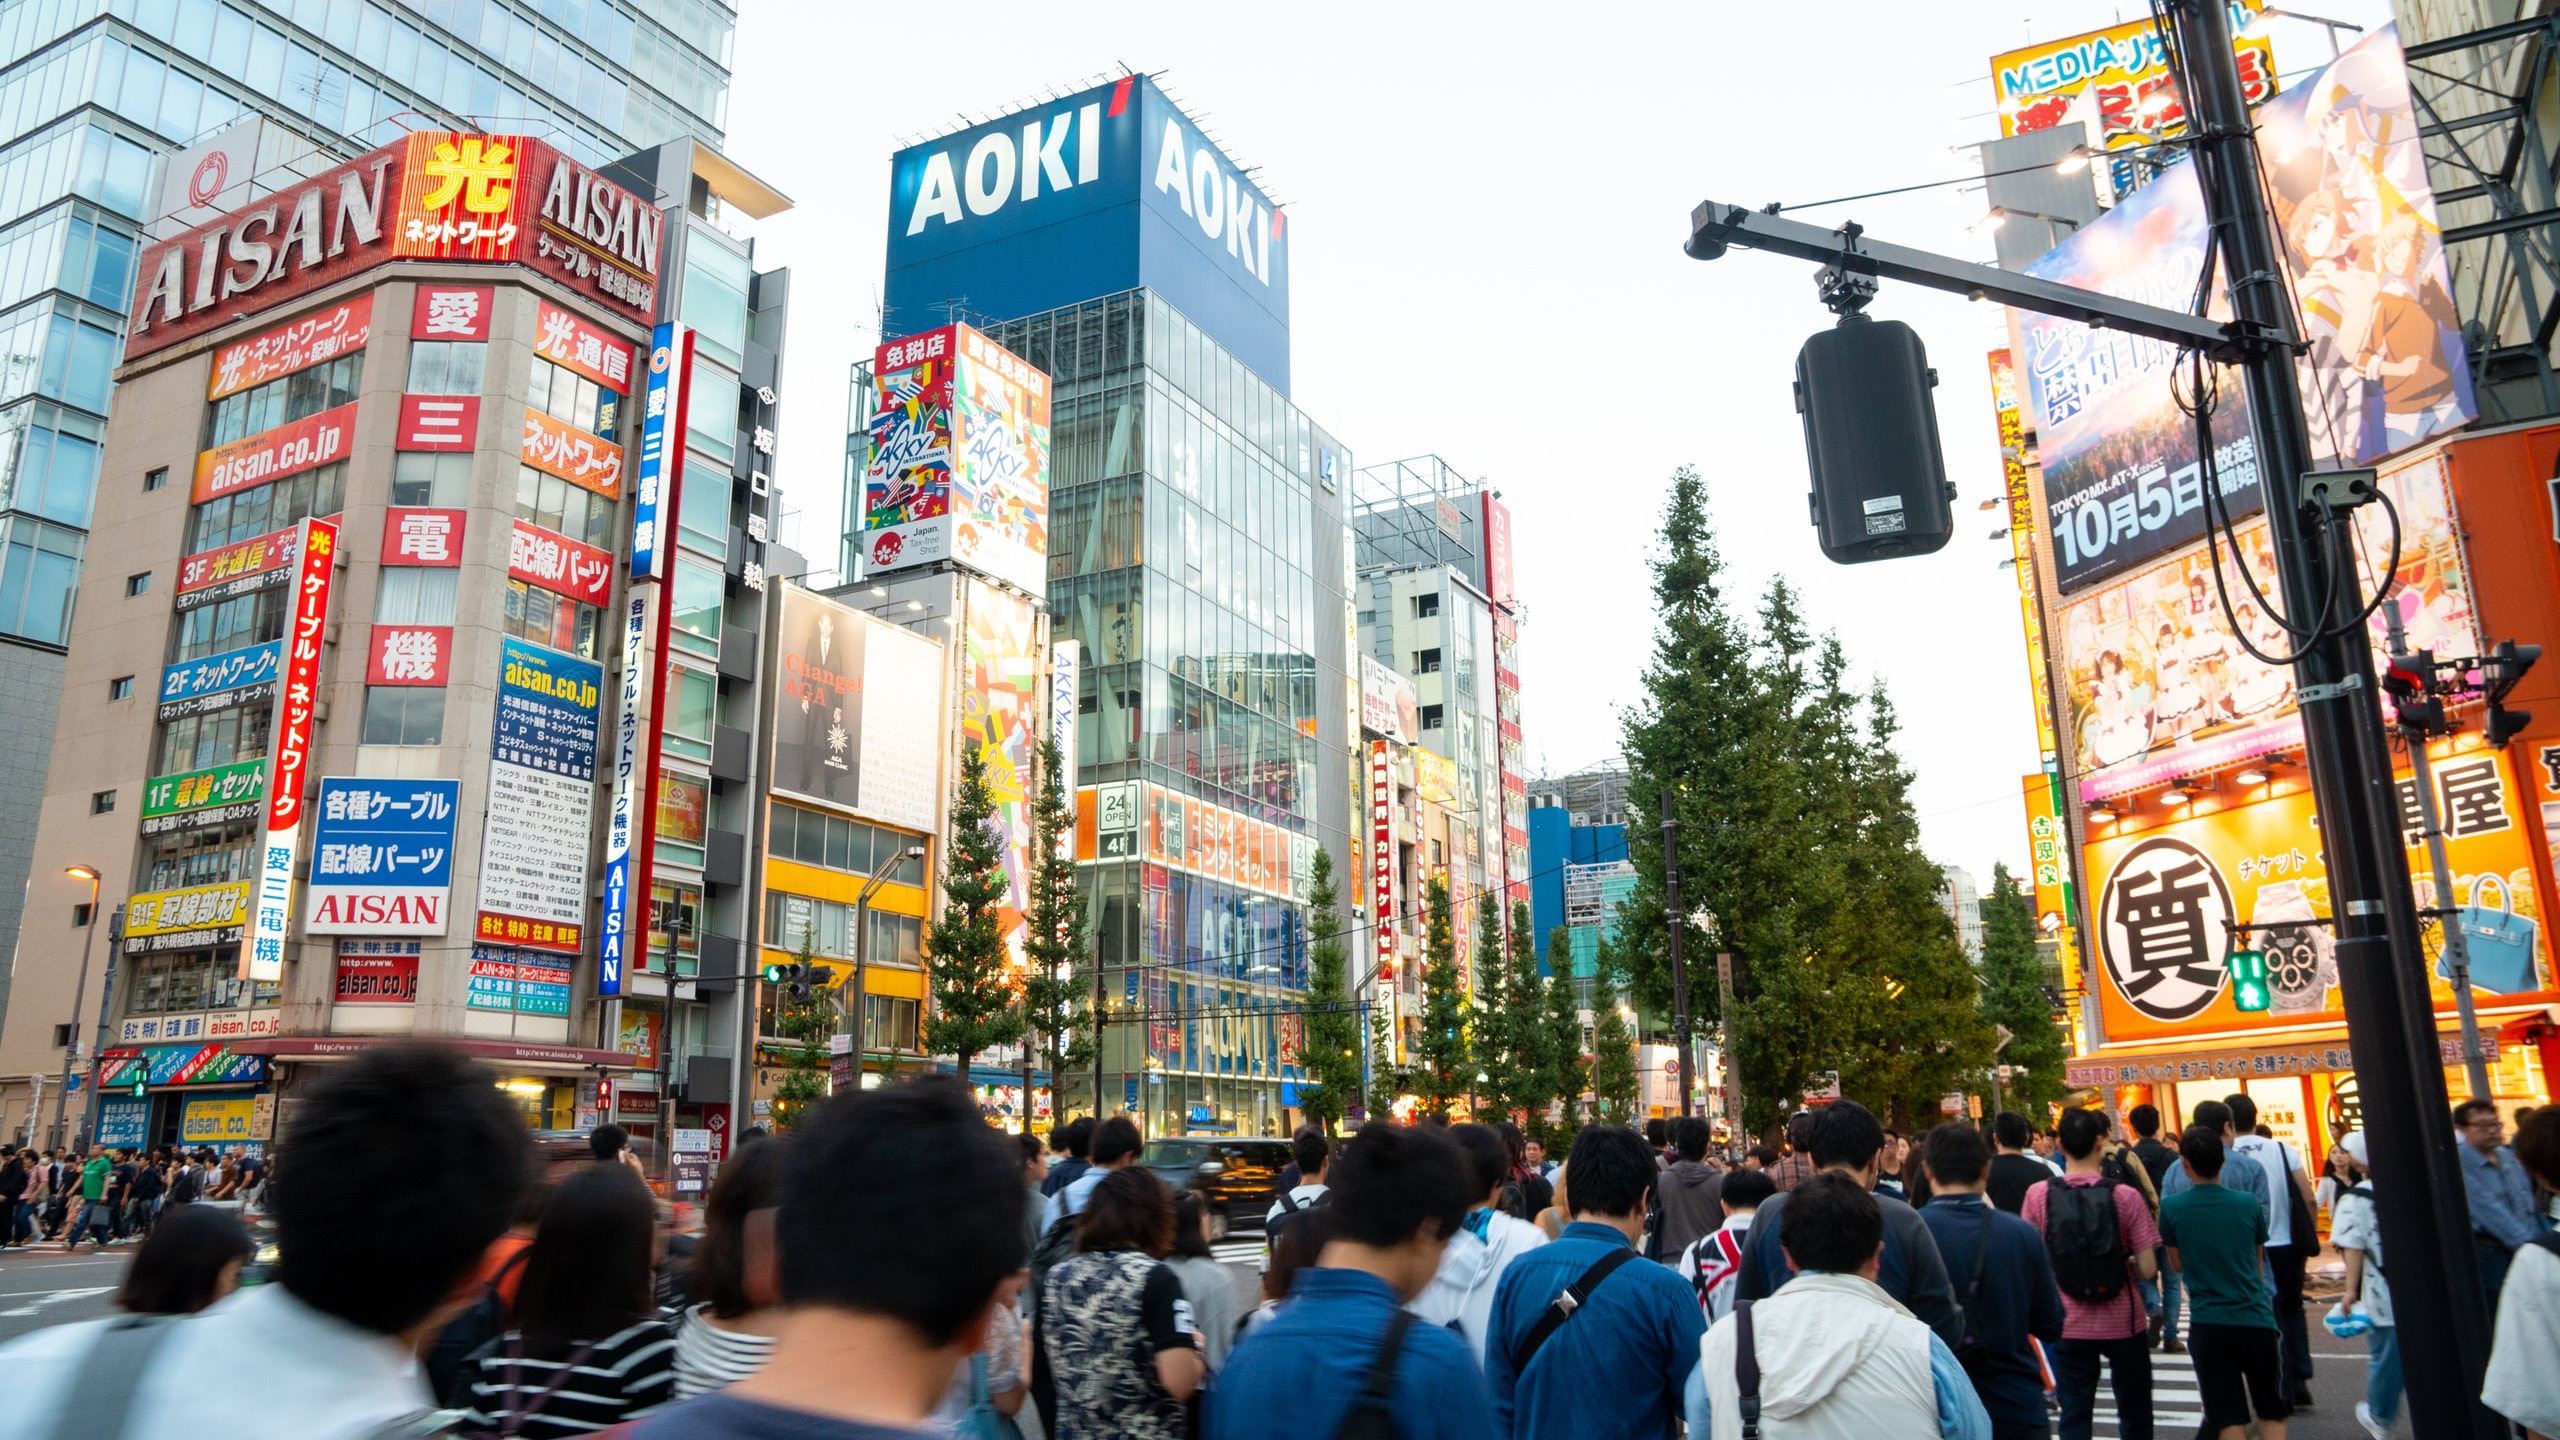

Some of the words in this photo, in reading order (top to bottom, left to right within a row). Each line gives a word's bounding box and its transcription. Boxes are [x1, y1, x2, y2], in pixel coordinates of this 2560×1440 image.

[422, 139, 514, 214] 光
[906, 102, 1101, 237] AOKI
[542, 156, 663, 277] AISAN
[1154, 116, 1269, 288] AOKI
[133, 155, 393, 335] AISAN
[405, 219, 517, 245] ネットワーク
[426, 291, 478, 335] 愛
[537, 311, 631, 385] 光通信
[885, 334, 946, 371] 免税店
[212, 345, 249, 397] 光
[411, 401, 463, 444] 三
[211, 424, 341, 492] aisan.co.jp
[522, 412, 622, 486] ネットワーク
[634, 386, 667, 553] 愛三電機
[876, 424, 936, 478] AKKY
[902, 449, 946, 465] INTERNATIONAL
[2214, 436, 2254, 472] 放送
[2218, 462, 2258, 497] 開始
[743, 425, 775, 592] 坂口電熱
[400, 514, 451, 562] 電
[910, 536, 940, 547] Tax-free
[919, 545, 940, 556] Shop
[183, 558, 208, 586] 3F
[509, 532, 610, 593] 配線パーツ
[382, 630, 437, 680] 機
[785, 653, 863, 696] Change!
[165, 668, 191, 696] 2F
[505, 661, 597, 709] aisan.co.jp
[784, 678, 827, 707] AGA
[1056, 652, 1073, 725] AKKY
[150, 782, 173, 809] 1F
[326, 790, 451, 821] 各種ケーブル
[319, 843, 444, 875] 配線パーツ
[2033, 816, 2058, 885] 吉野家
[130, 900, 157, 928] B1F
[256, 846, 291, 963] 愛三電機
[313, 894, 439, 925] AISAN
[603, 865, 624, 983] AISAN
[482, 916, 503, 936] 各社
[507, 919, 529, 939] 特約
[532, 923, 554, 943] 在庫
[557, 926, 578, 945] 直販
[2113, 853, 2229, 1001] 質
[338, 969, 417, 999] aisan.co.jp
[1126, 971, 1138, 1006] AOKI
[124, 1022, 139, 1040] 各社
[1202, 1003, 1261, 1060] AOKI
[1126, 1078, 1138, 1113] AOKI
[2068, 1067, 2116, 1085] 高価買取
[1191, 1107, 1210, 1122] AOKI
